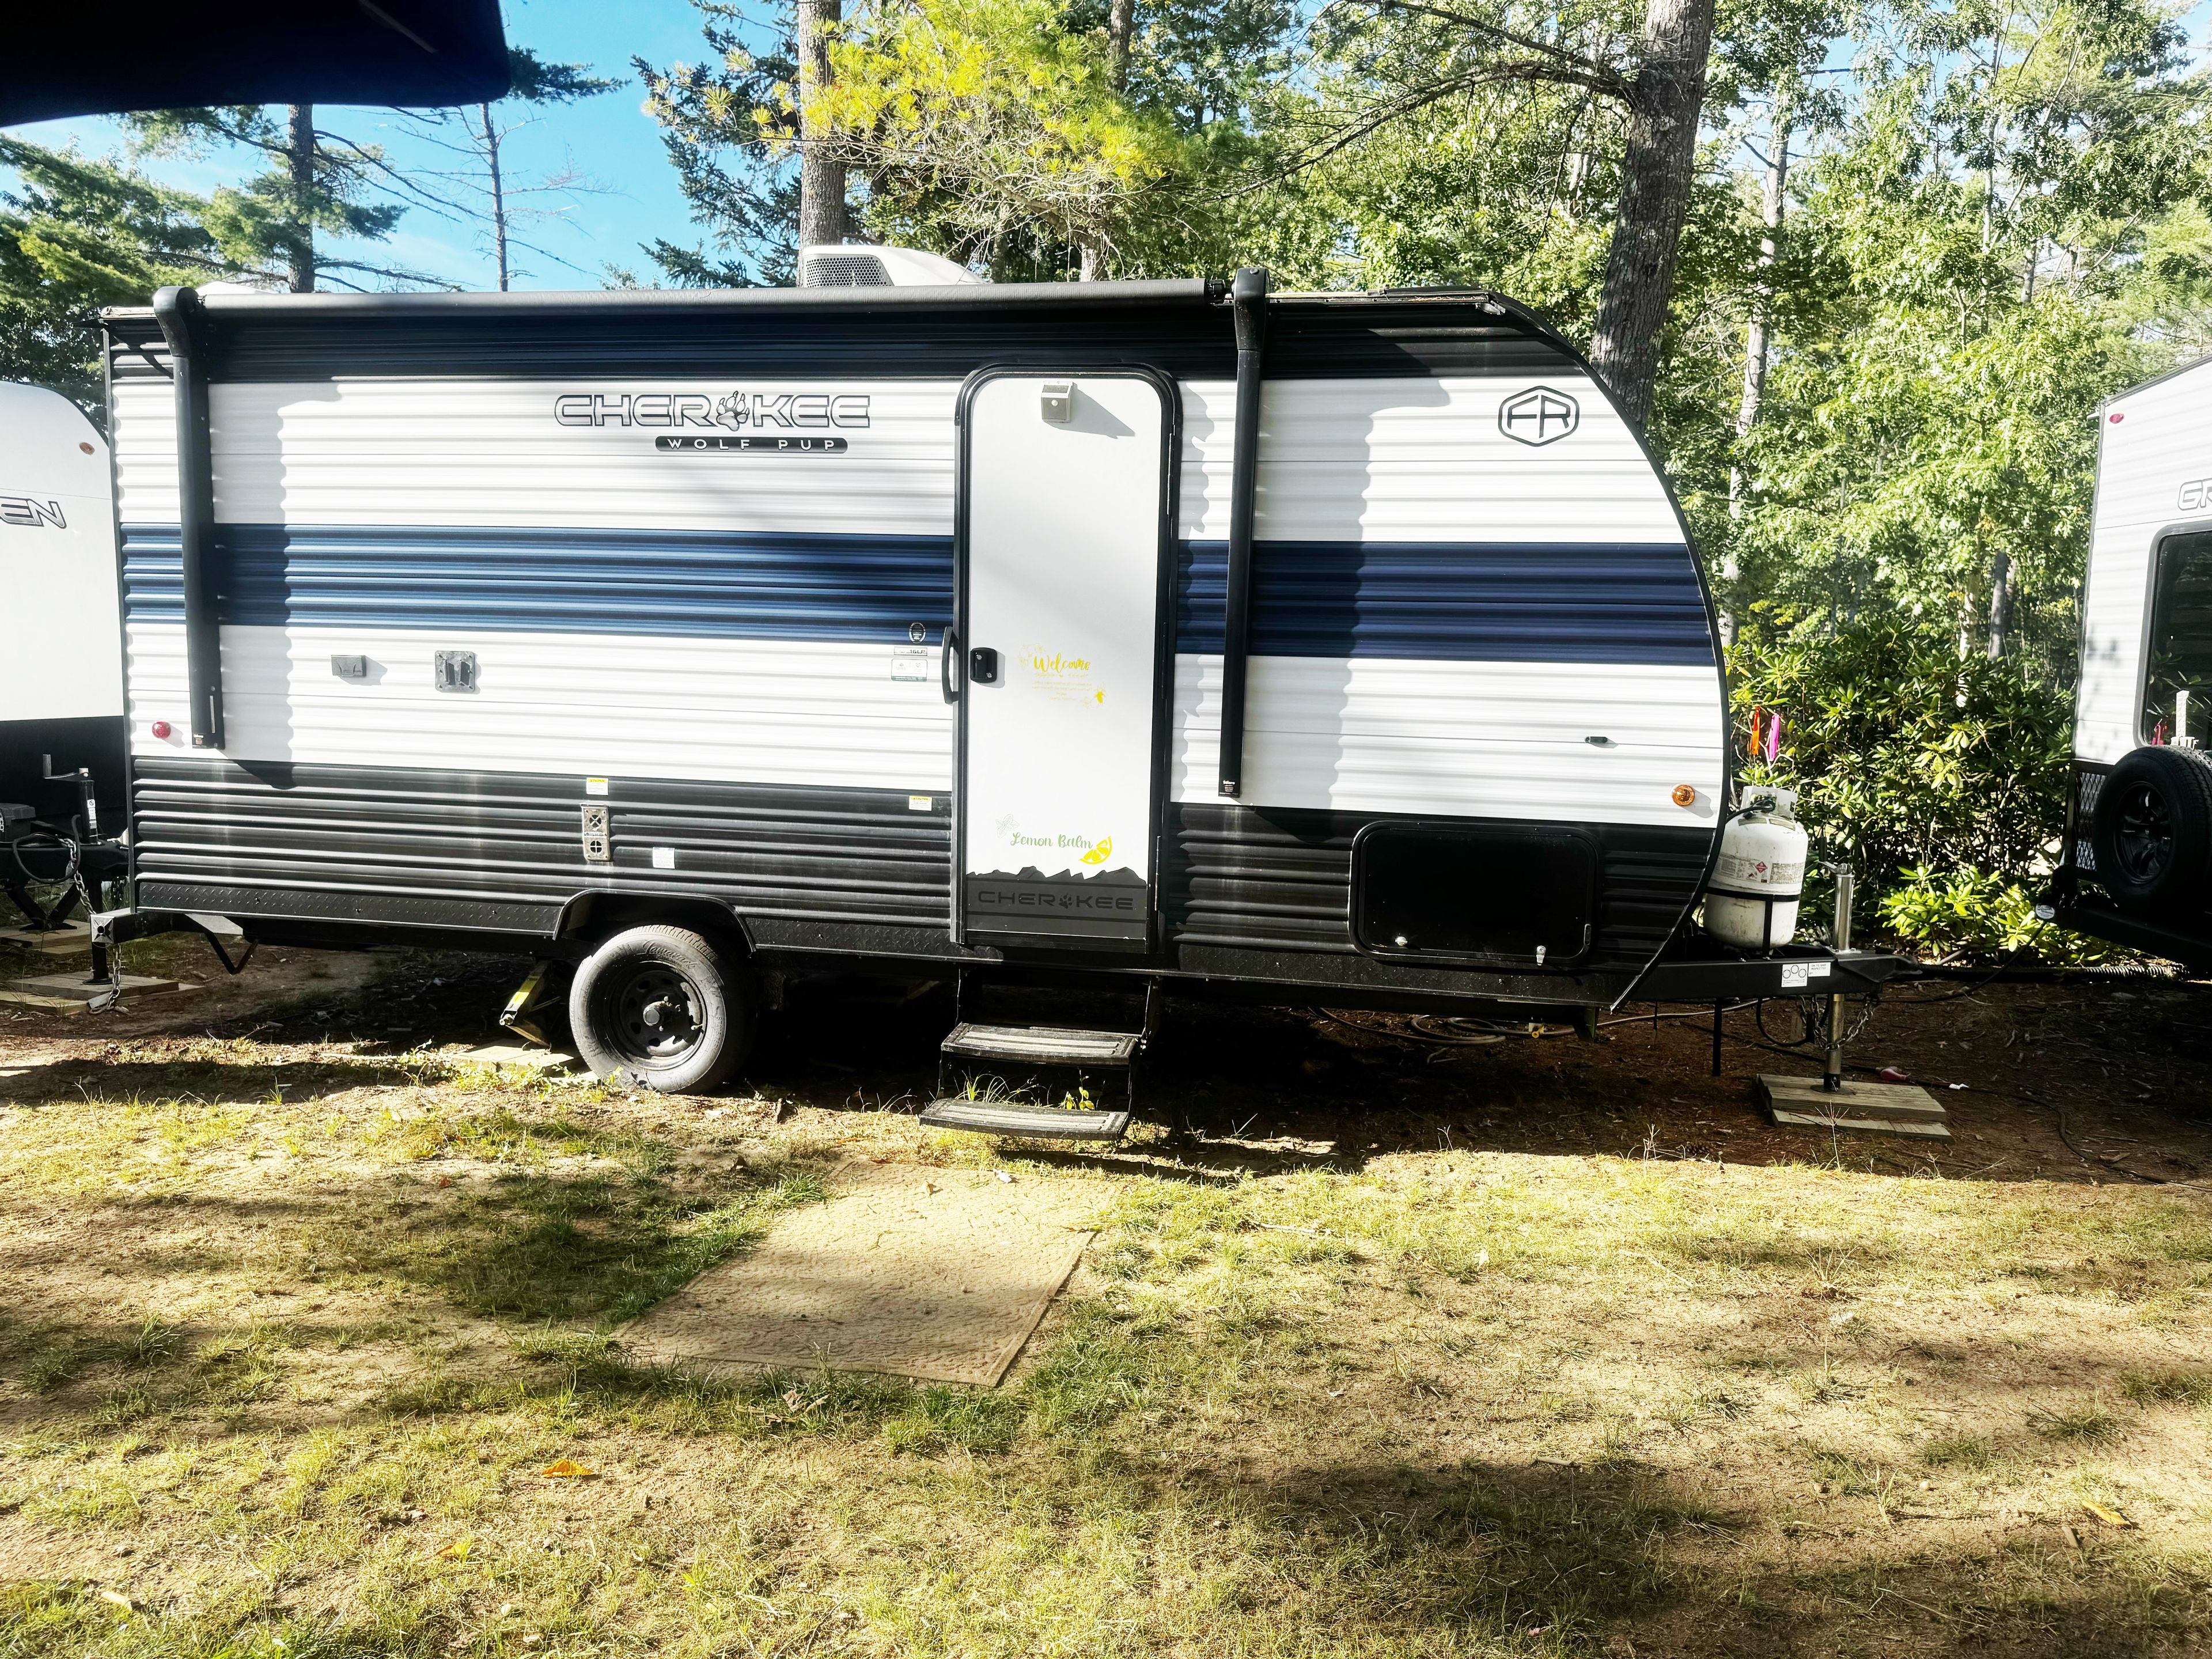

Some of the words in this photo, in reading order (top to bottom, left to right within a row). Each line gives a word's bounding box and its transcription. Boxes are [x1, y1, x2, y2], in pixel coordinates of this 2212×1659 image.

[666, 438, 751, 450] WOLF
[778, 440, 835, 451] PUP
[1033, 652, 1091, 673] Welcome
[1010, 831, 1054, 847] Lemon
[1058, 834, 1093, 849] Balm
